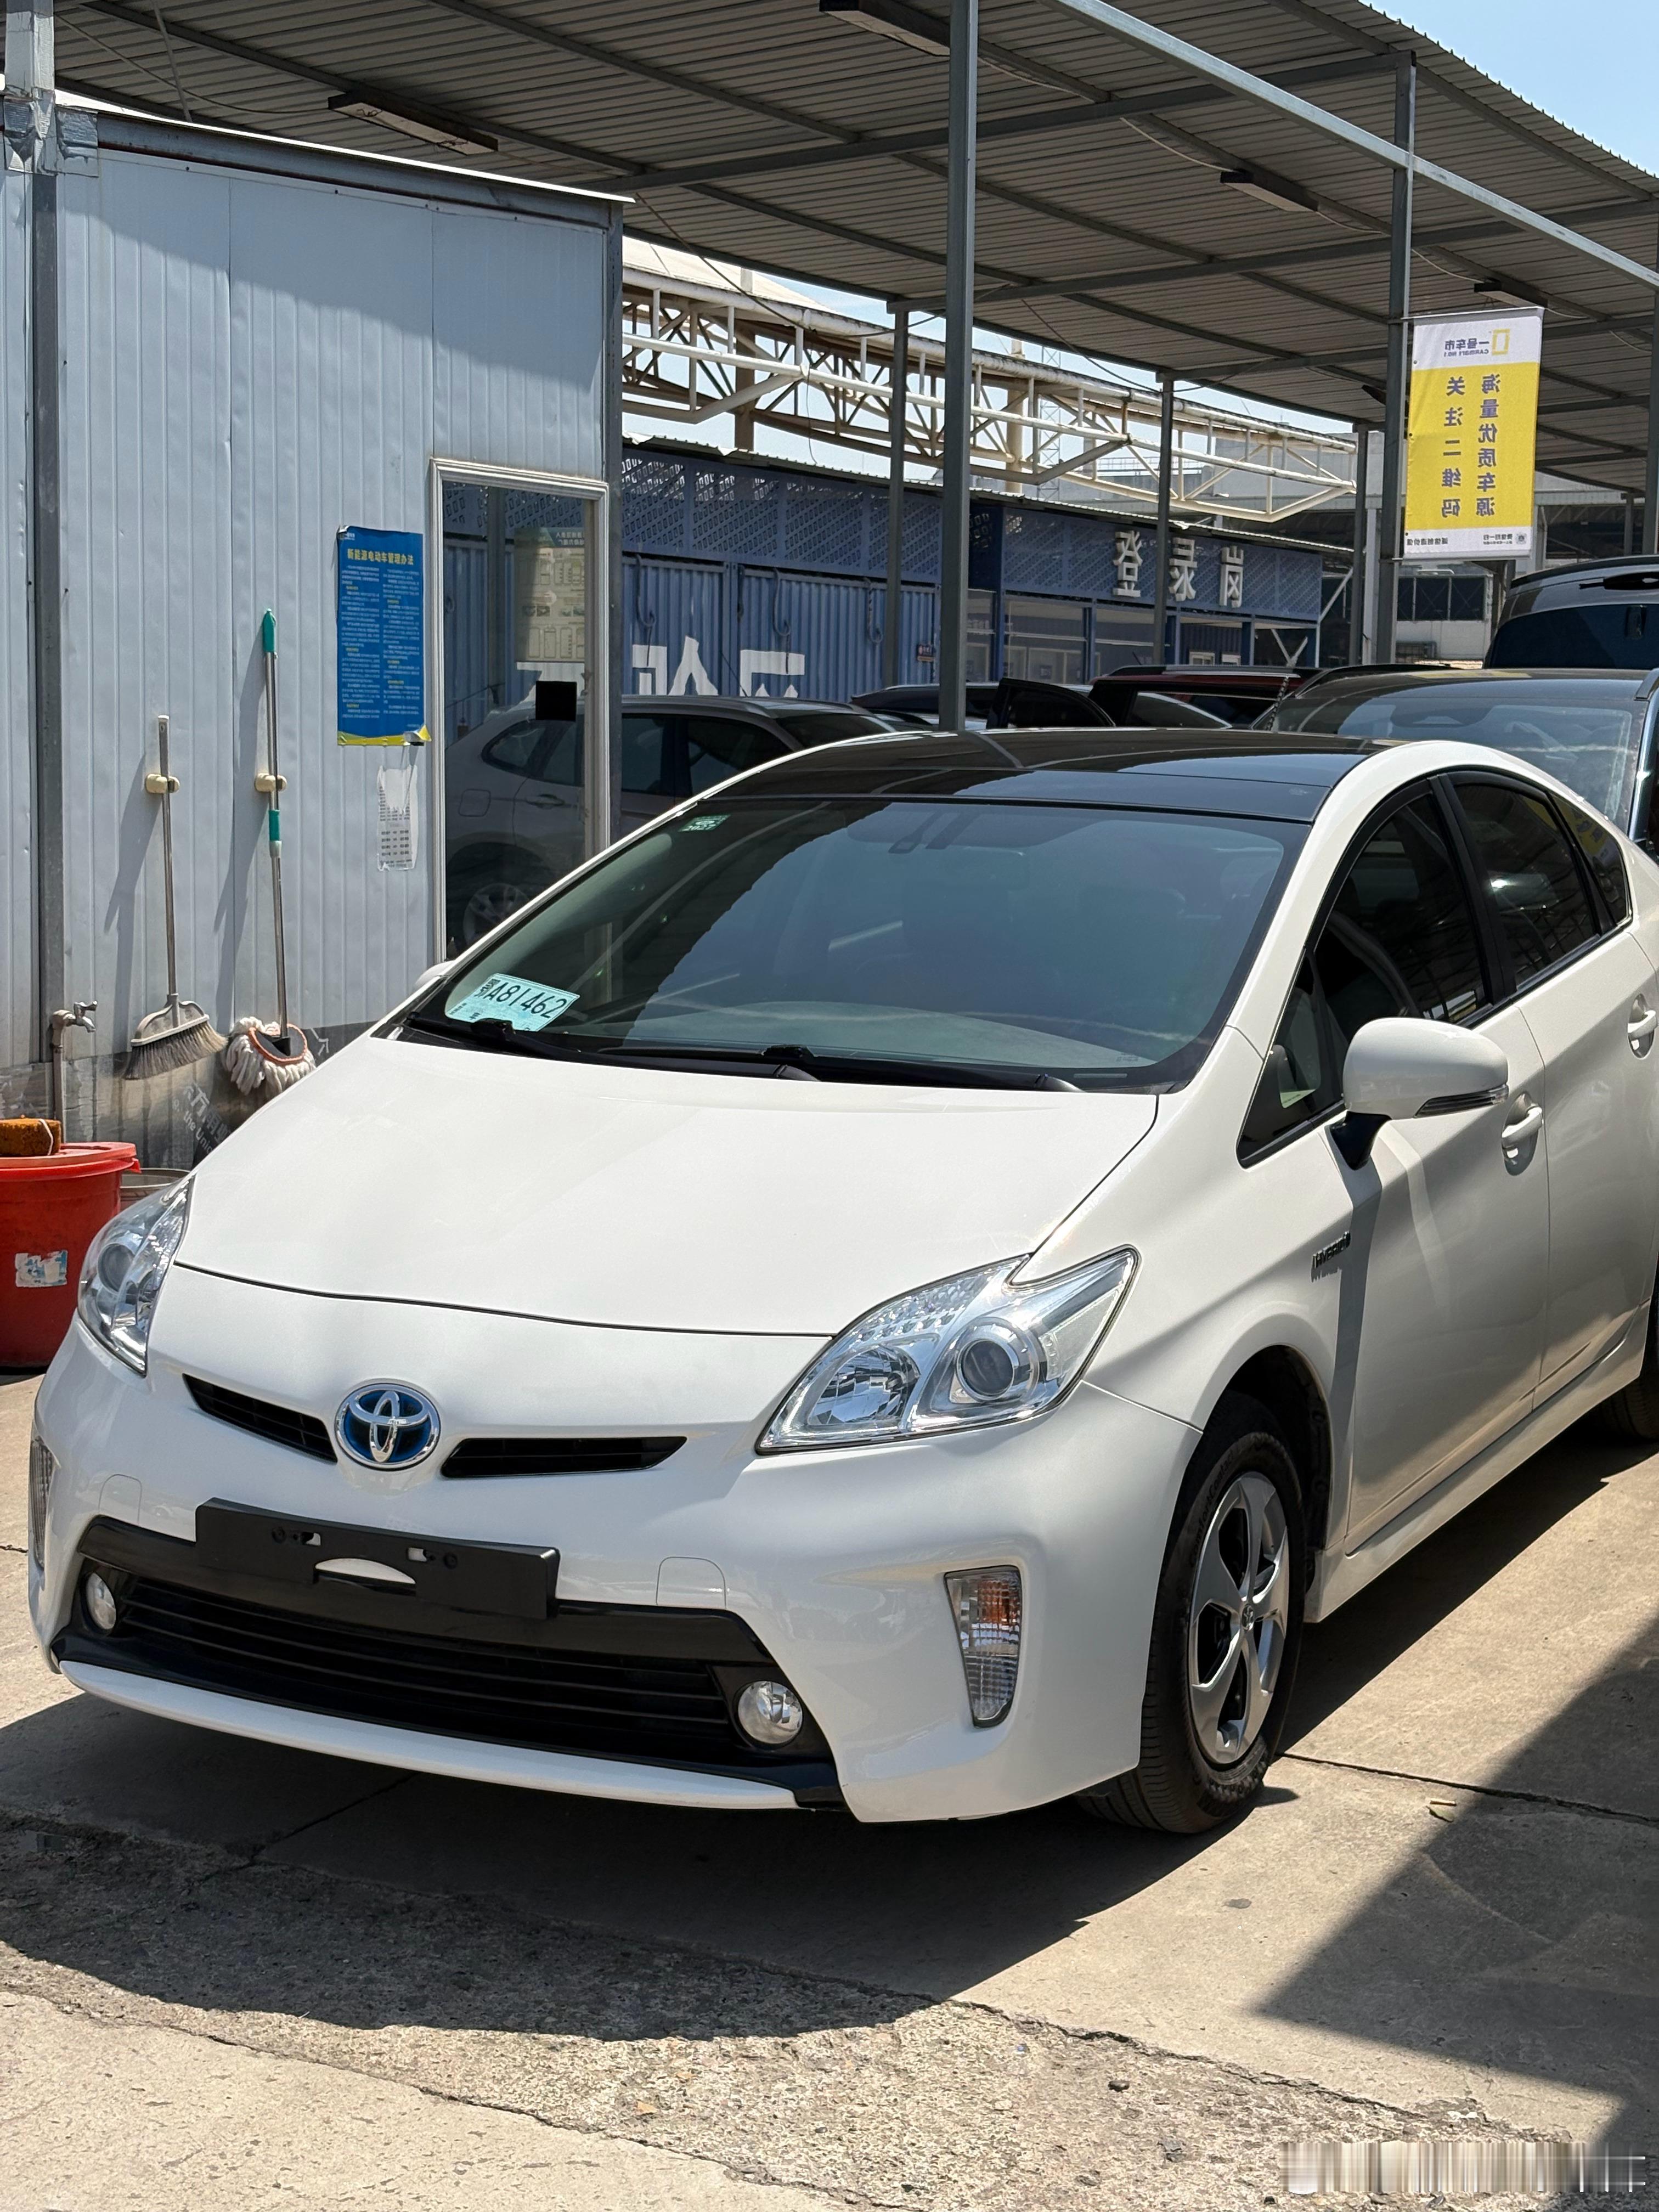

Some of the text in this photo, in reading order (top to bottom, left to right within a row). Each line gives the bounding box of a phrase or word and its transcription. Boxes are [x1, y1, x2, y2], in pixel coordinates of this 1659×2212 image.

[347, 548, 414, 565] 新能源电动车管理办法
[1113, 530, 1244, 608] 登录岗
